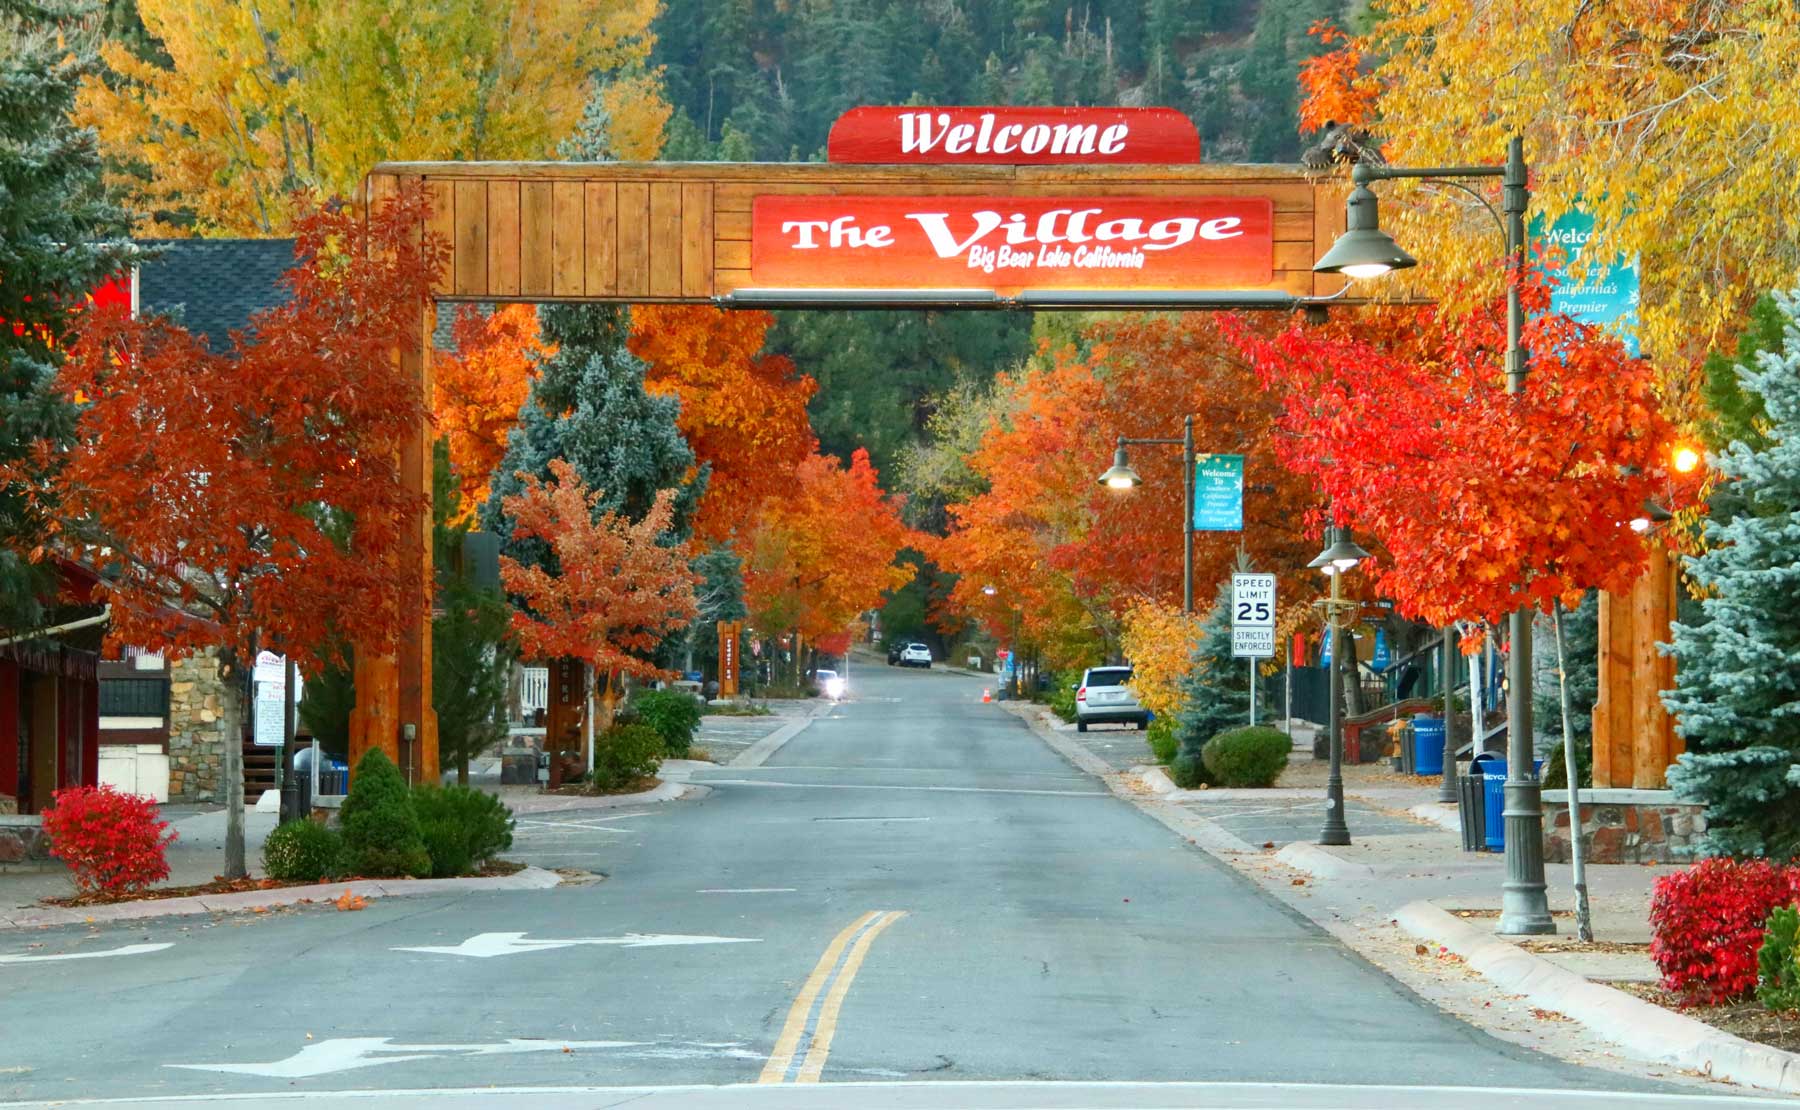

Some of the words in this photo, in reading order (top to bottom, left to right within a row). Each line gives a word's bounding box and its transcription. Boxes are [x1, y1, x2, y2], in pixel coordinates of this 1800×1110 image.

[898, 113, 1129, 154] Welcome
[782, 215, 895, 249] The
[905, 208, 1244, 259] Village
[1544, 227, 1607, 244] Welco
[967, 244, 995, 273] Big
[997, 245, 1034, 268] Bear
[1037, 244, 1071, 268] Lake
[1073, 245, 1145, 269] California
[1558, 300, 1608, 312] Premier
[1202, 469, 1236, 477] Welcome
[1235, 579, 1272, 587] SPEED
[1239, 591, 1268, 599] LIMIT
[1237, 602, 1270, 621] 25
[1236, 631, 1270, 640] STRICTLY
[1234, 642, 1272, 650] ENFORCED
